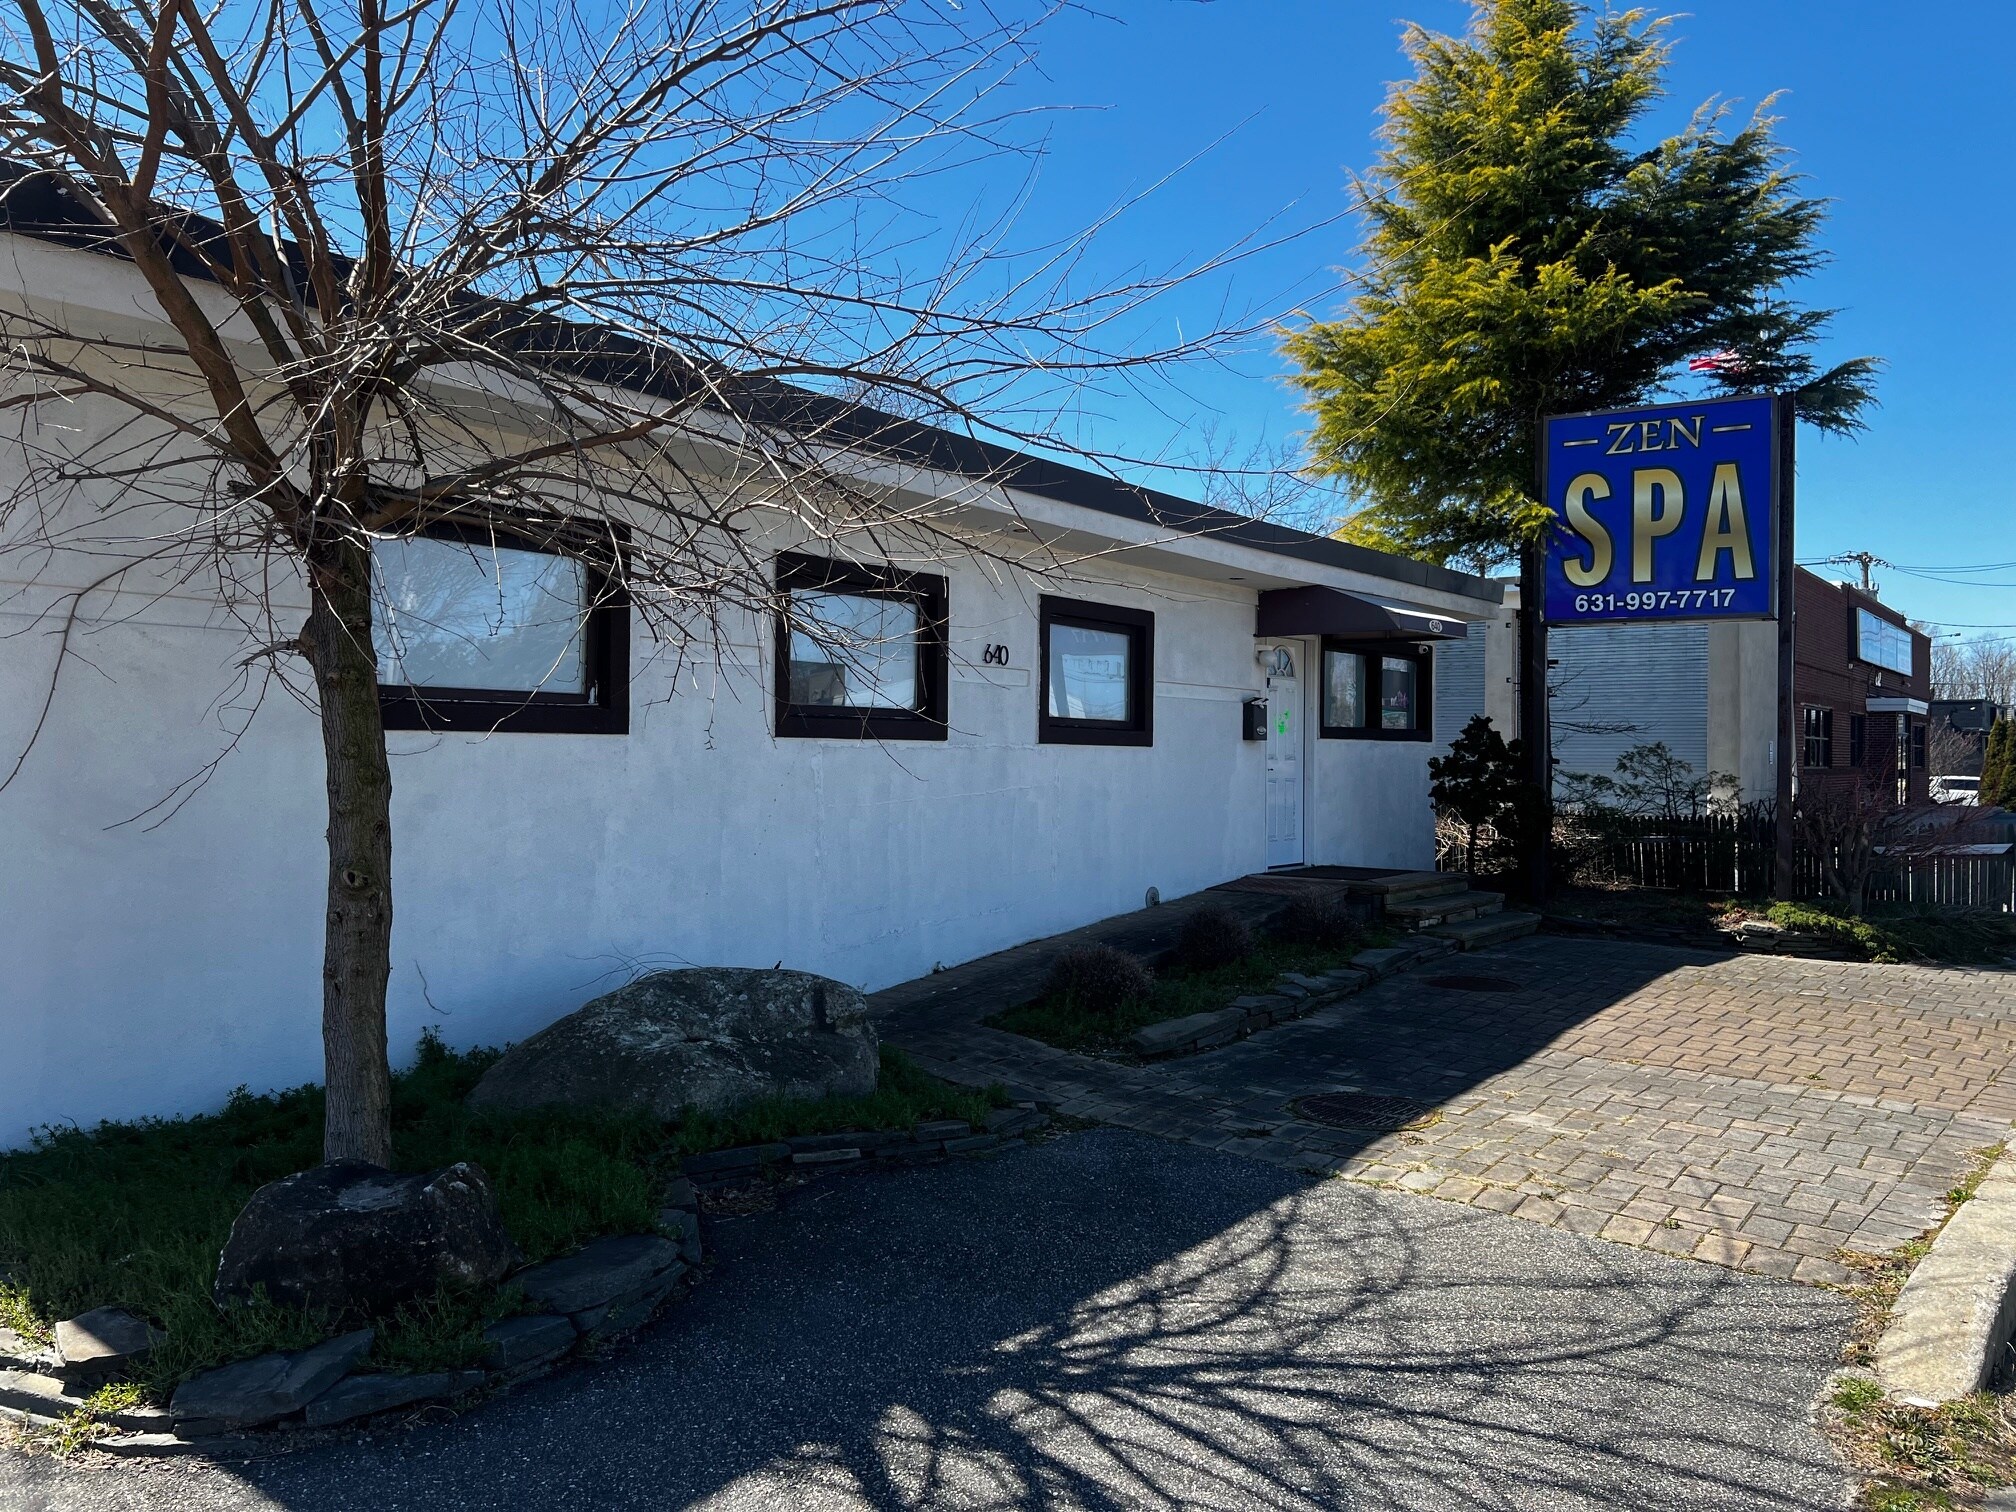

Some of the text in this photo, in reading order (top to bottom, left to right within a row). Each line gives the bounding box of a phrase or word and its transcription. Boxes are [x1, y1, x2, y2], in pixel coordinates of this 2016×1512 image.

[1606, 416, 1705, 455] ZEN
[1563, 463, 1754, 587] SPA
[1575, 589, 1735, 612] 631-997-7717
[983, 644, 1009, 666] 640
